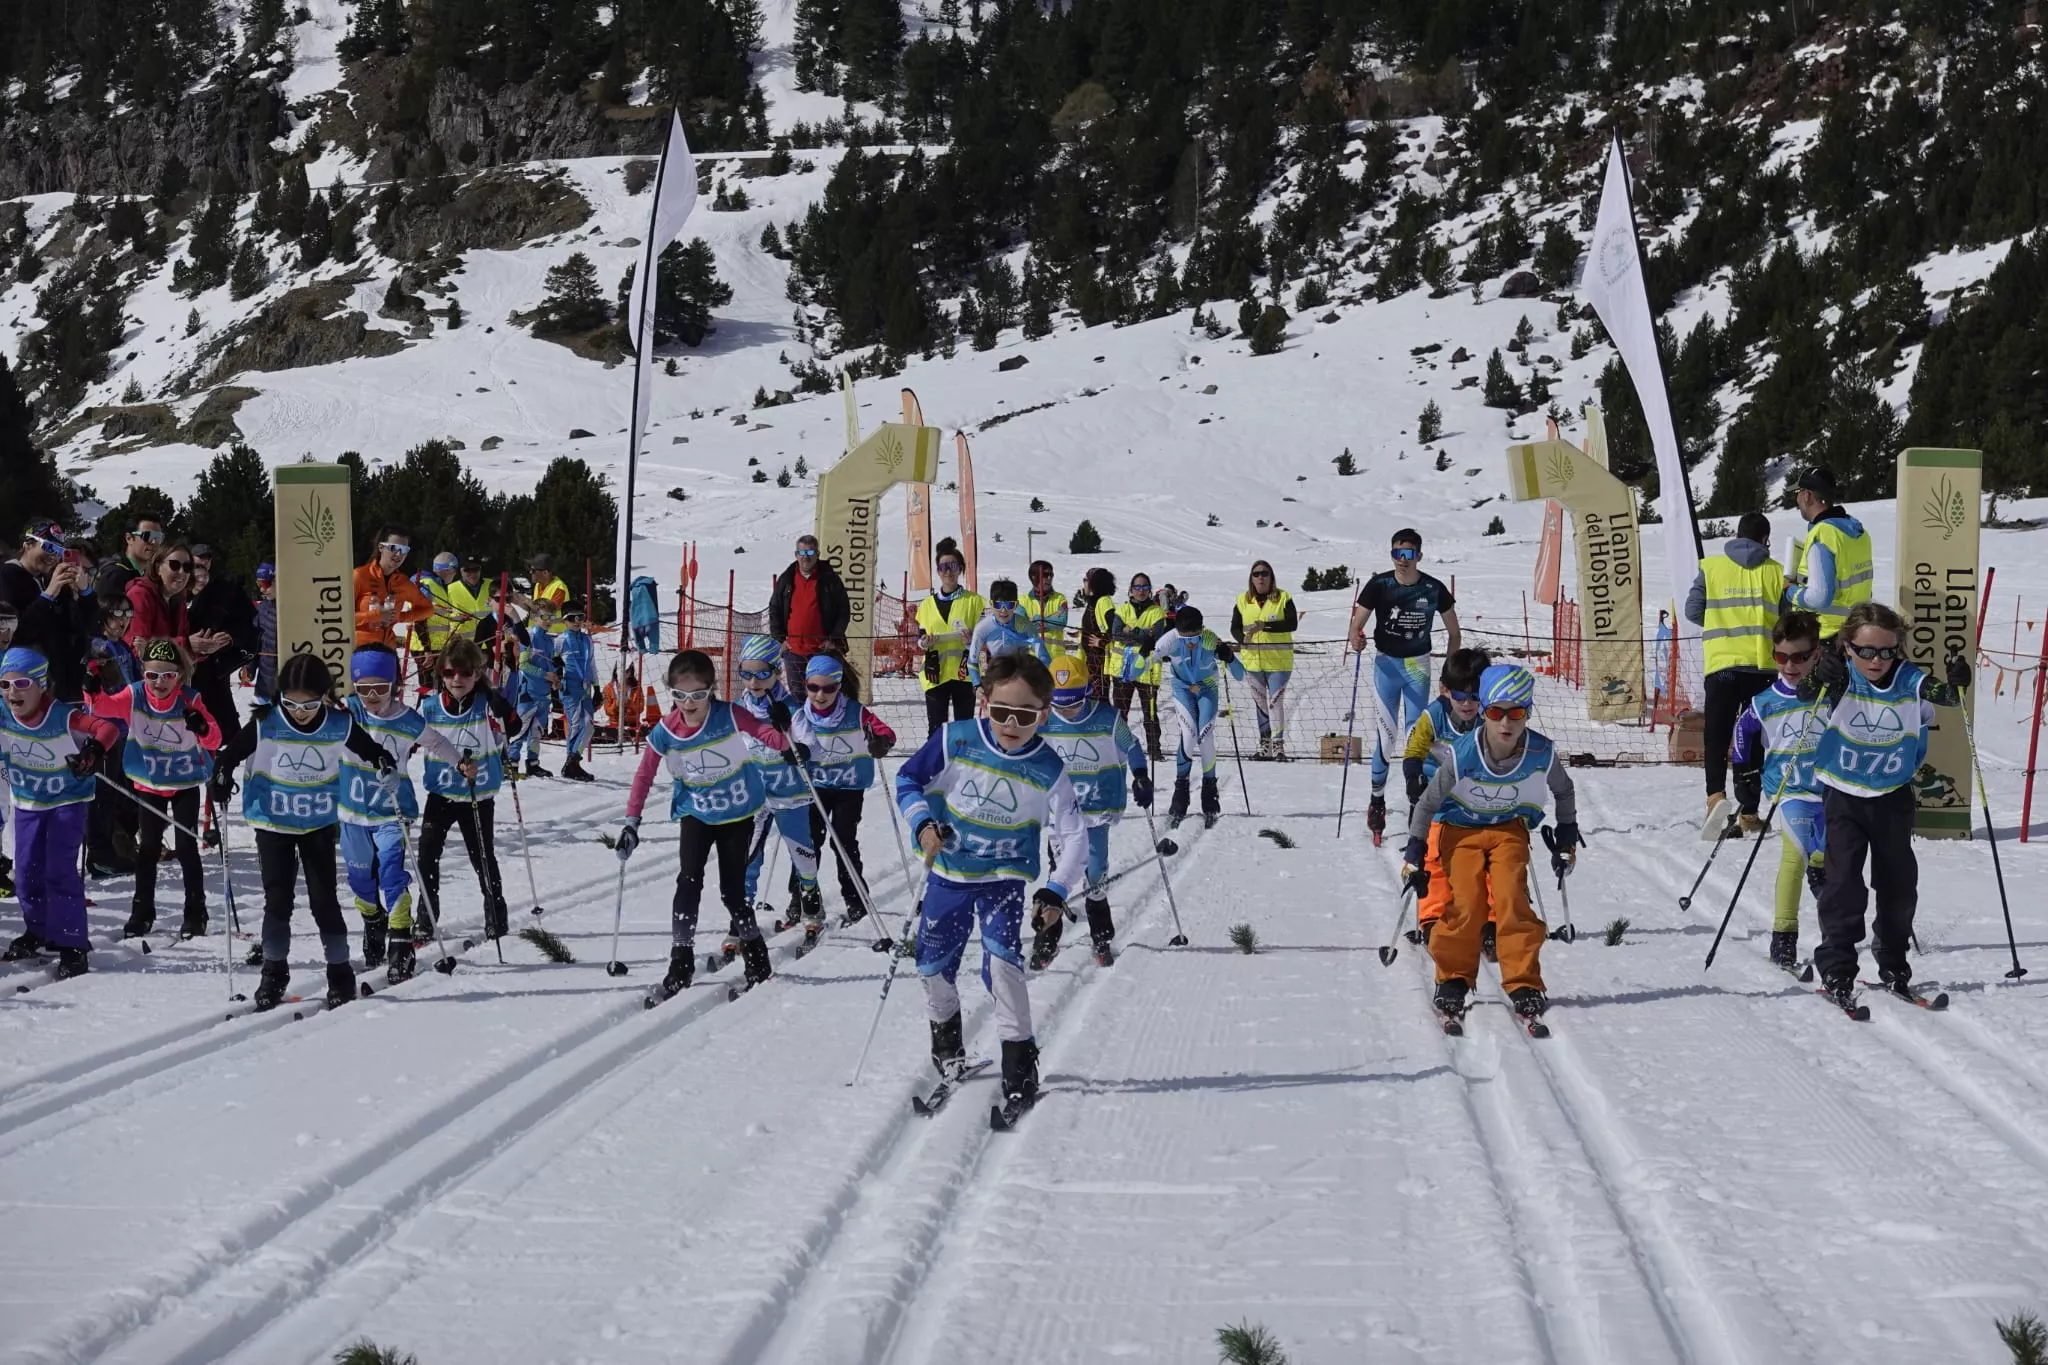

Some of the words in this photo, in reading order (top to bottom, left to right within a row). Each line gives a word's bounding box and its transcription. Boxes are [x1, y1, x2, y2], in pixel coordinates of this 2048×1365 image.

[1585, 513, 1605, 539] del
[845, 498, 872, 592] Hospital
[1608, 512, 1633, 587] Llanos
[1587, 541, 1618, 637] Hospital
[1914, 562, 1937, 597] del
[1839, 745, 1904, 775] 076
[8, 768, 64, 794] 070
[270, 790, 332, 817] 069
[978, 812, 1013, 825] aneto
